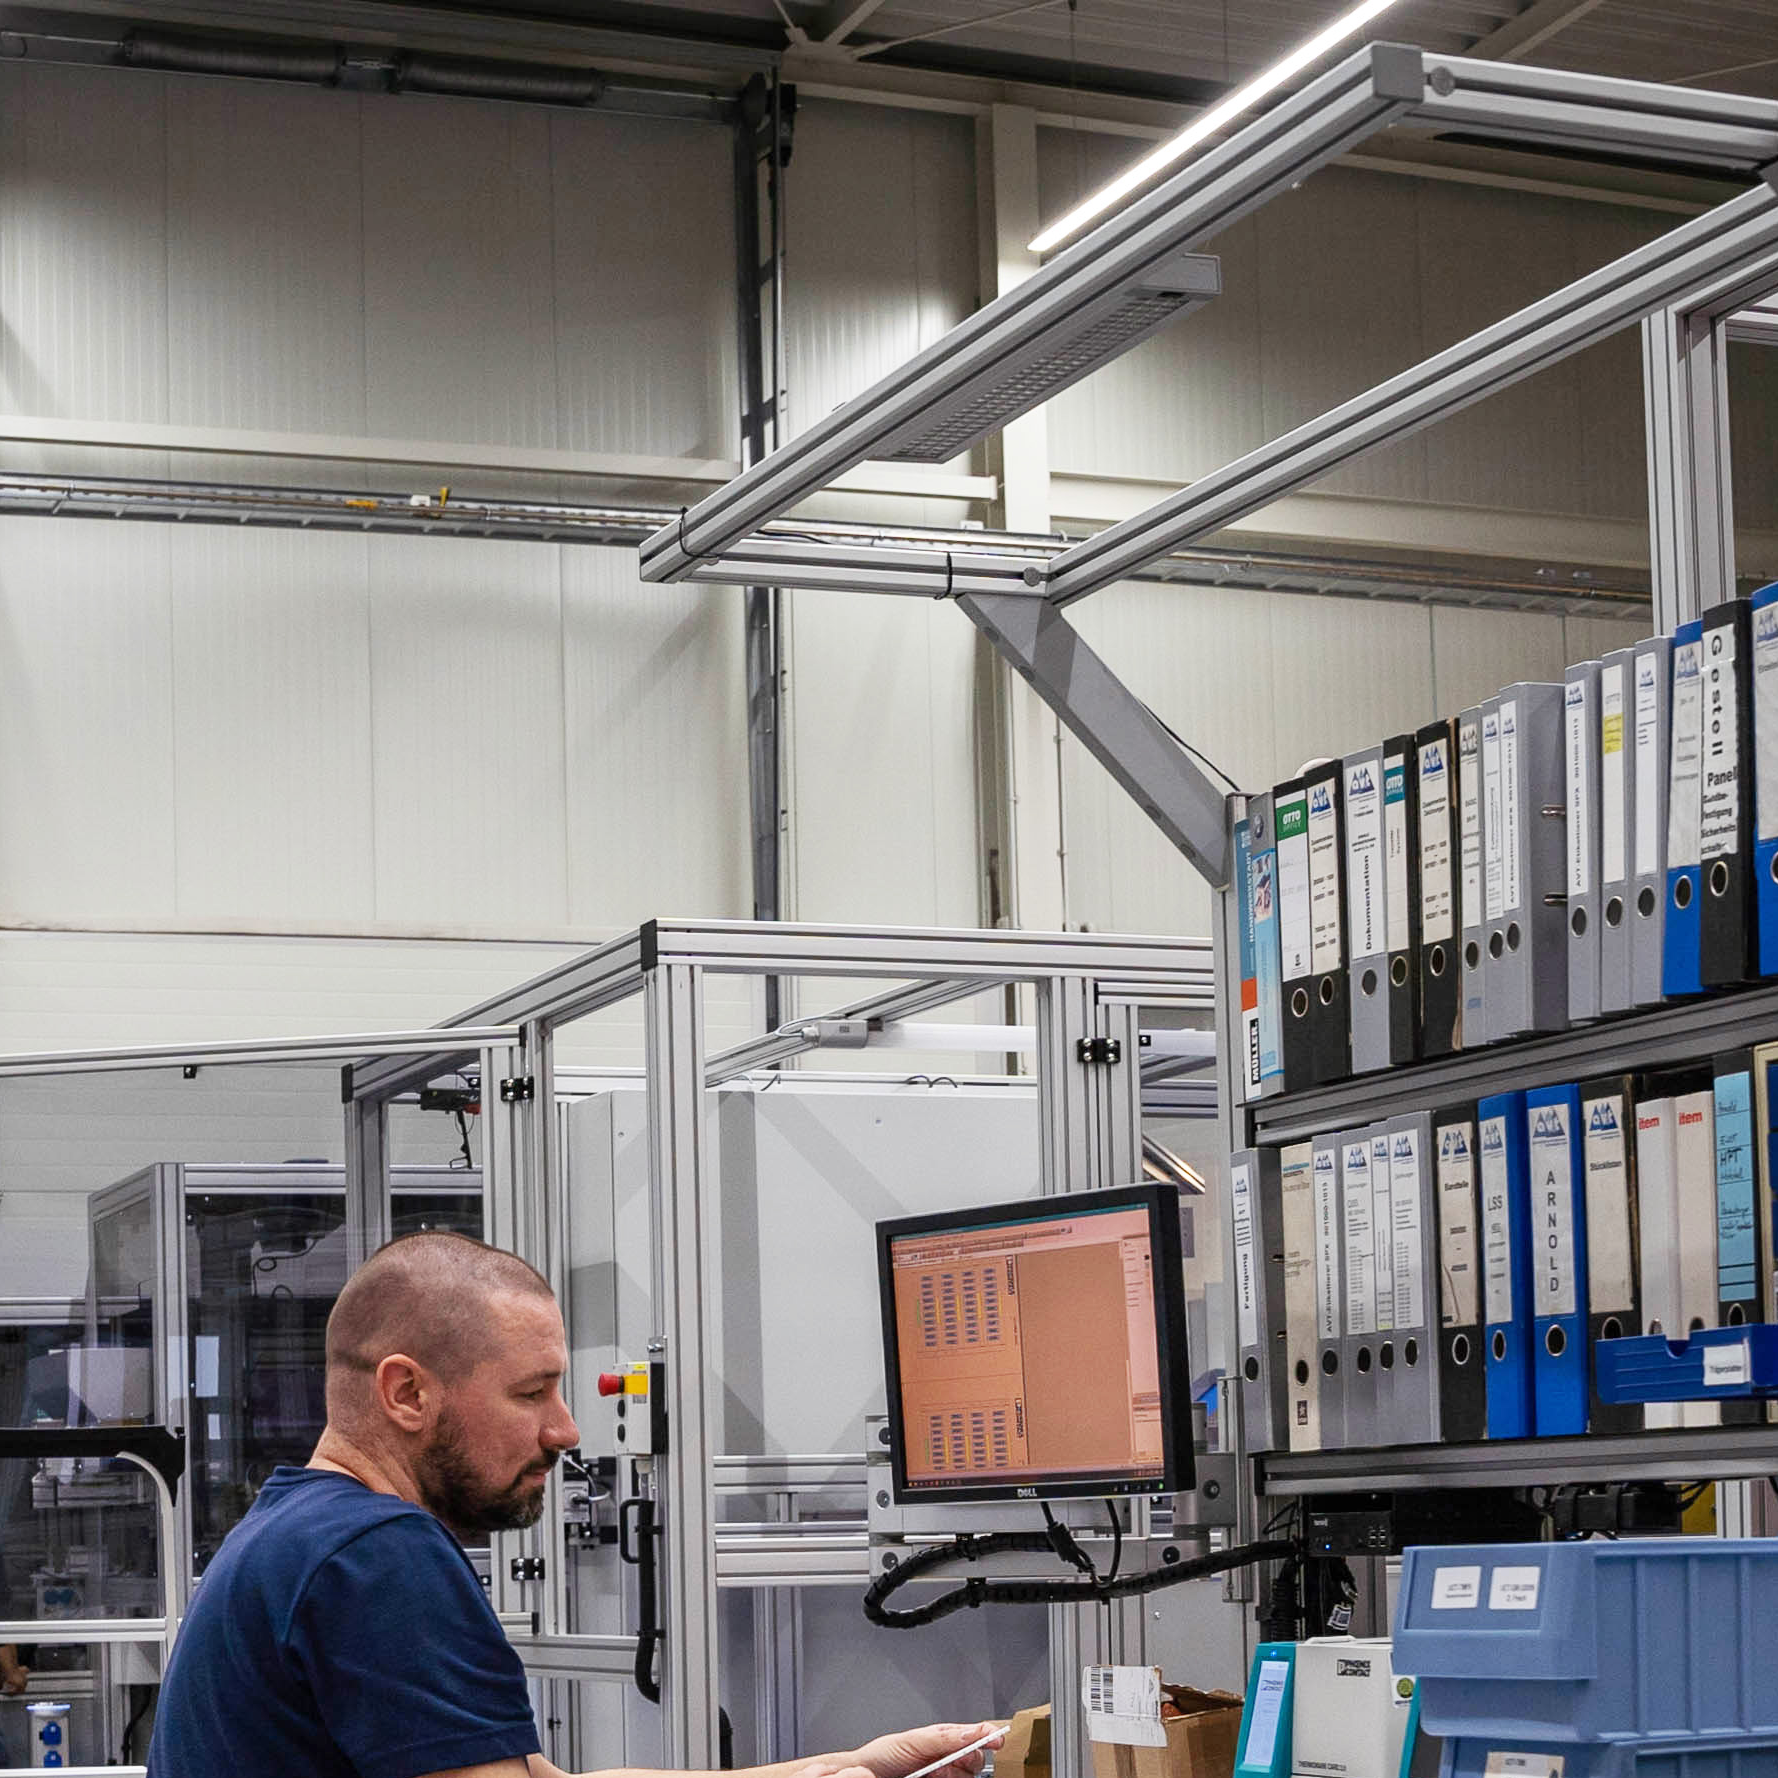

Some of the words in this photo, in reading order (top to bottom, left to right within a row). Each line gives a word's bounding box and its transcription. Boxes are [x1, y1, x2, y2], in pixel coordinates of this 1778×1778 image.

[1385, 774, 1403, 789] OTTO
[1282, 809, 1300, 825] OTTO
[1638, 1117, 1660, 1130] item
[1678, 1111, 1703, 1125] item
[1546, 1170, 1559, 1292] ARNOLD
[1017, 1487, 1037, 1498] DELL
